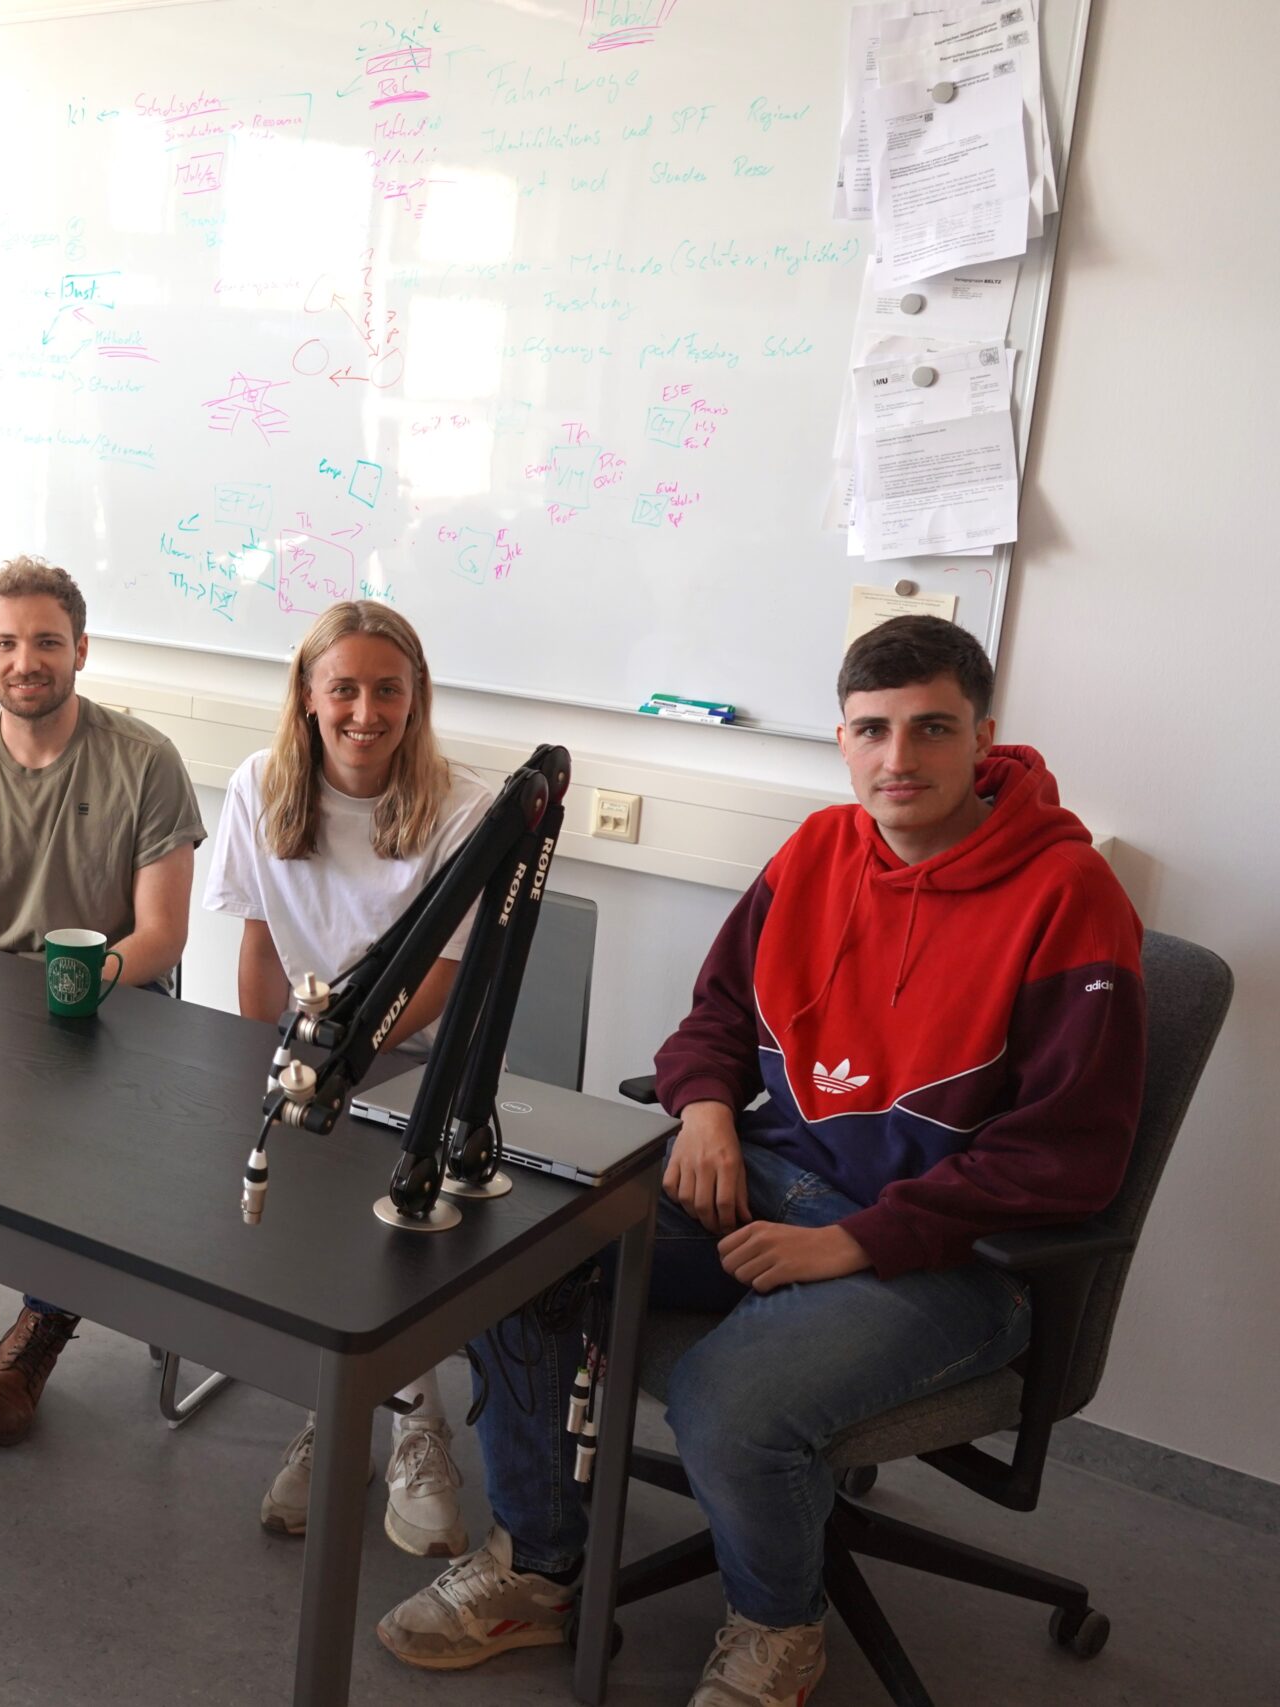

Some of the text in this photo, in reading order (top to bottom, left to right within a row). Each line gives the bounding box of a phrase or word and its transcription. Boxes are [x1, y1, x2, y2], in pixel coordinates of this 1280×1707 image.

[561, 423, 590, 447] Th
[498, 862, 527, 928] RØDE
[529, 837, 555, 901] RØDE
[1084, 979, 1114, 992] adid
[371, 987, 410, 1051] RØDE
